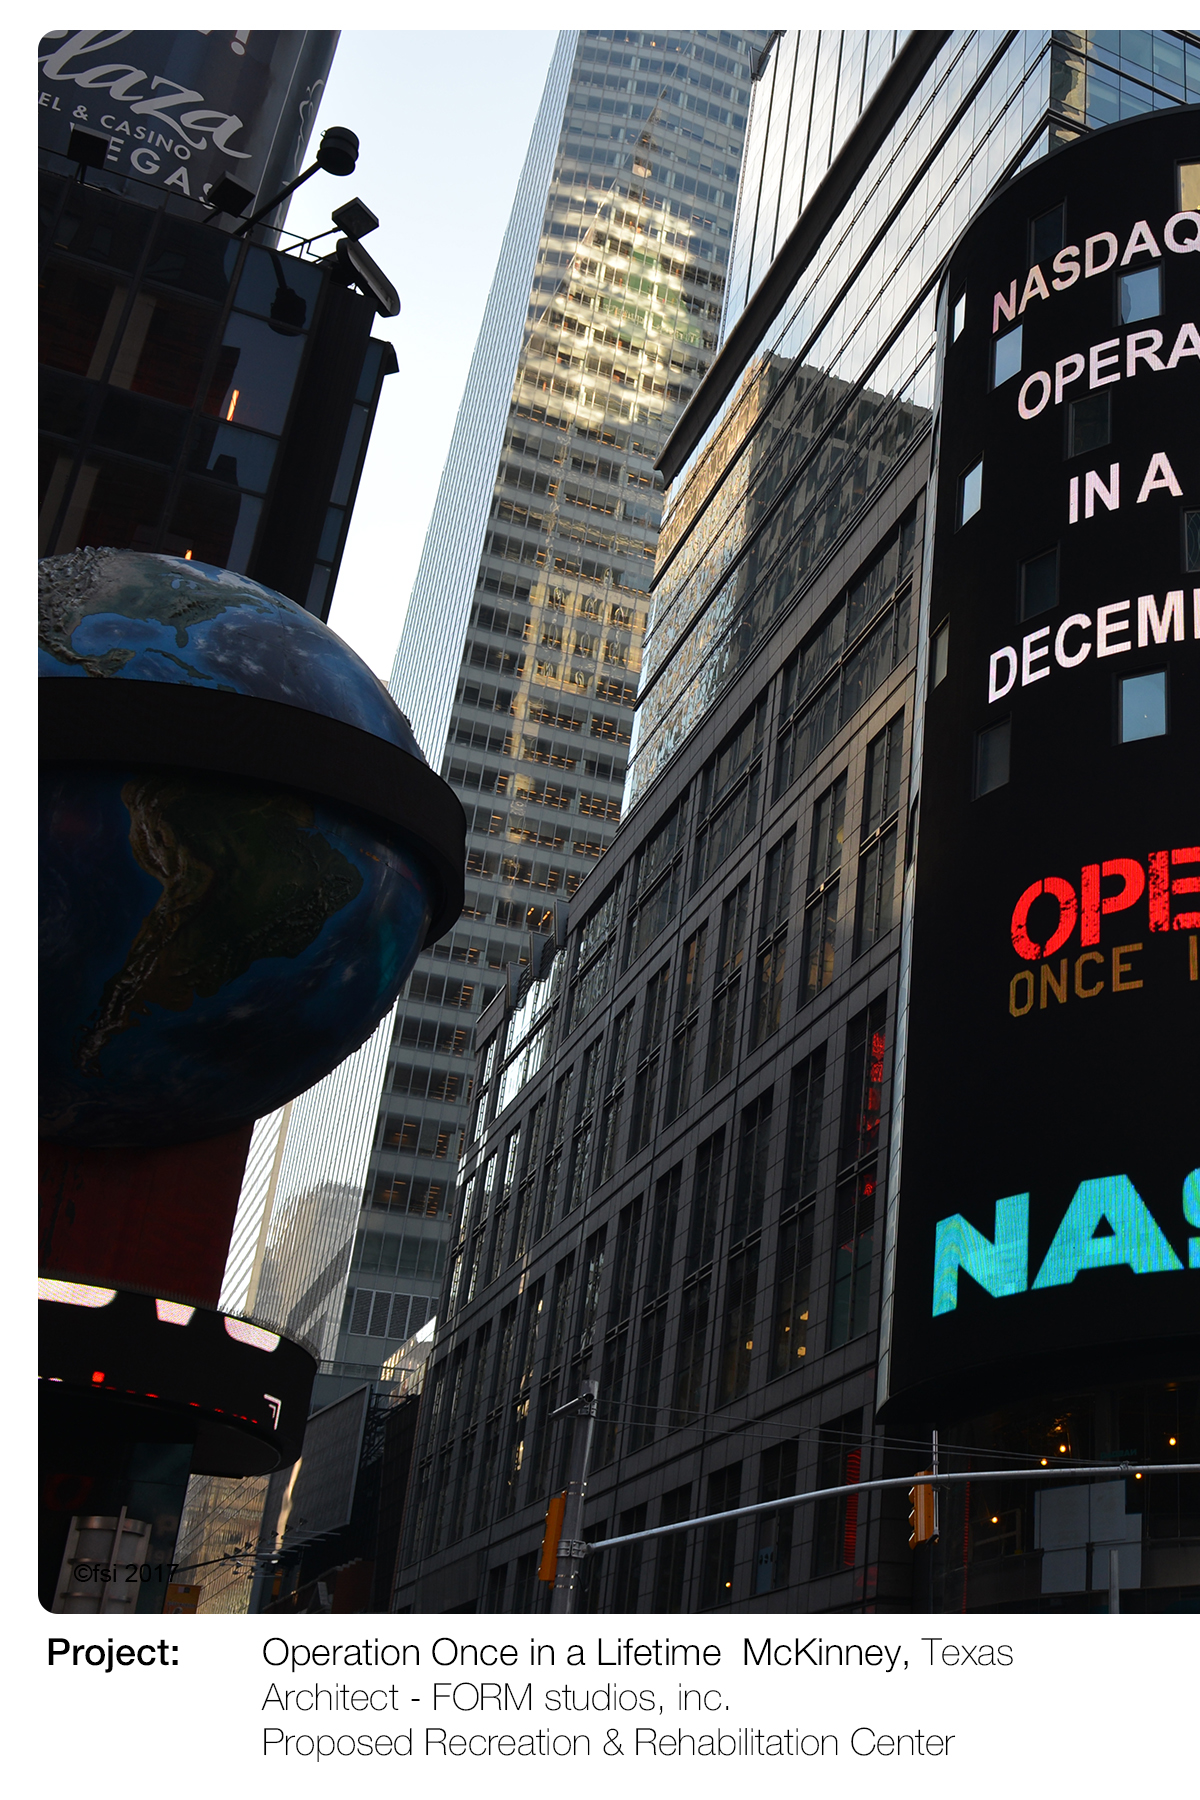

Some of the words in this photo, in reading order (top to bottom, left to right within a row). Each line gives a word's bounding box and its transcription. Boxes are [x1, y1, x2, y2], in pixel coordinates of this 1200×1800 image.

[38, 30, 253, 158] laza
[38, 91, 61, 111] EL
[72, 105, 89, 121] &
[100, 114, 191, 160] CASINO
[70, 121, 218, 210] EGA
[1068, 462, 1120, 524] IN
[1136, 452, 1183, 504] A
[1008, 942, 1144, 1017] ONCE
